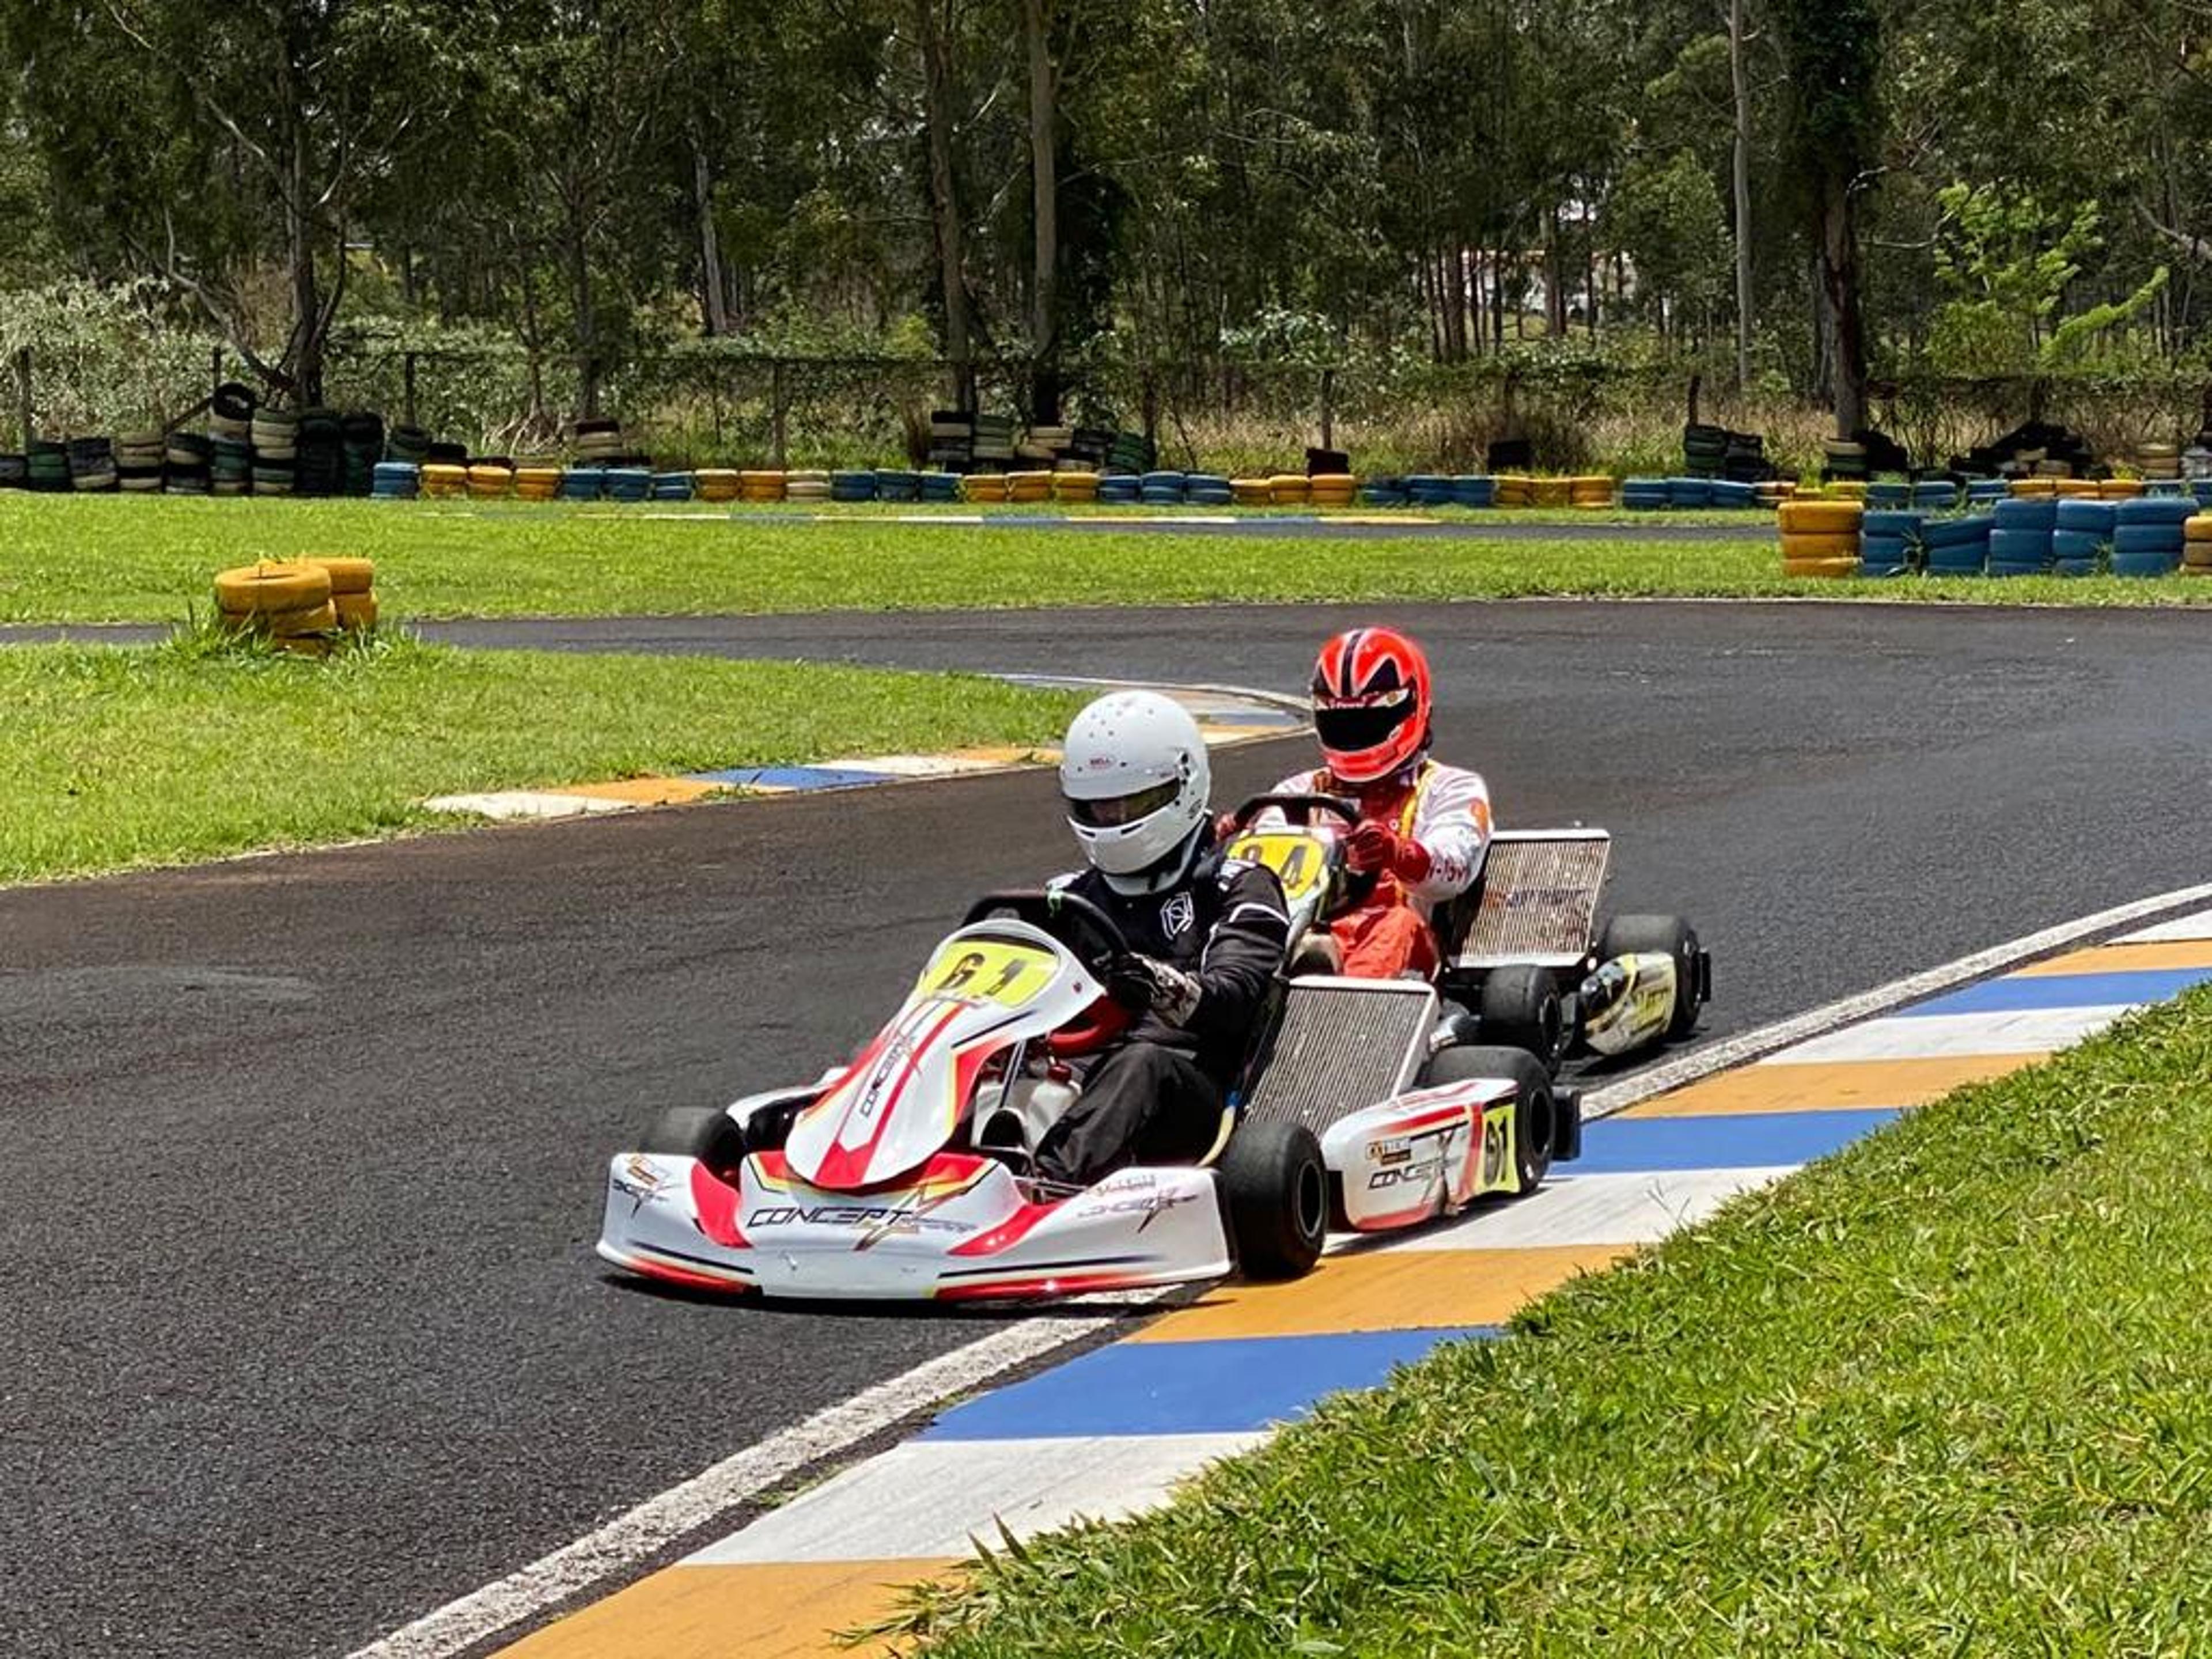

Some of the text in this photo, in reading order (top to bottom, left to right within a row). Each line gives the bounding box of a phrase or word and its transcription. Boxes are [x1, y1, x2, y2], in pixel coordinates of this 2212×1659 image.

[935, 952, 1028, 996] 61
[1484, 1116, 1507, 1186] 61
[748, 1207, 912, 1228] CONCEPT
